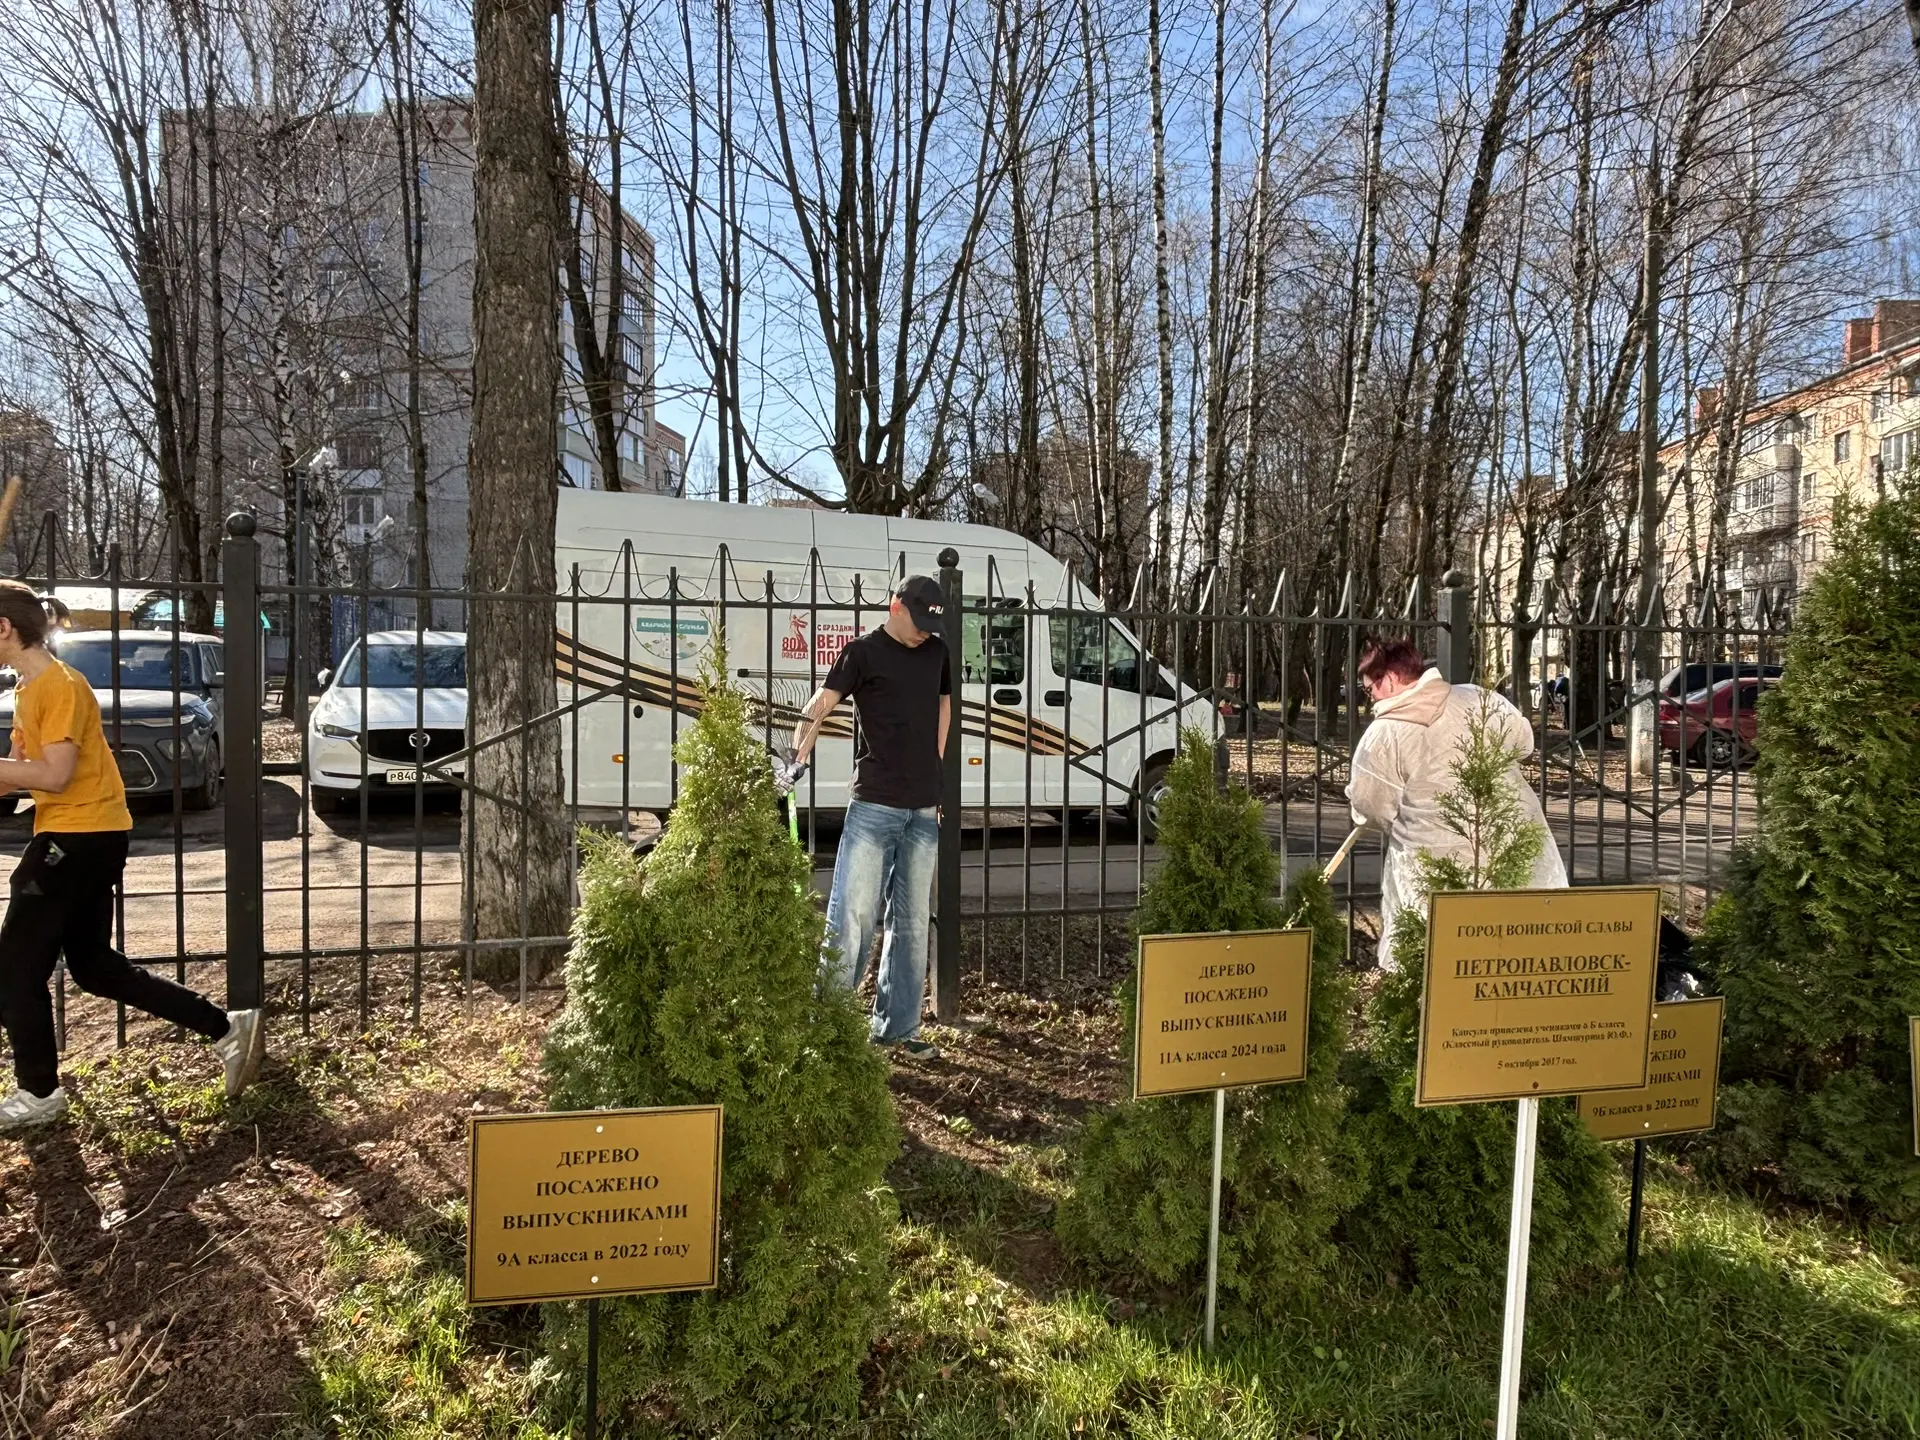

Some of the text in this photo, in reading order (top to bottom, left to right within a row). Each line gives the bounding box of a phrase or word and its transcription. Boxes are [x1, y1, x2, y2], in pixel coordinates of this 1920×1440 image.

[822, 624, 866, 633] ПРАЗДНИМ
[782, 637, 798, 651] 80
[1457, 920, 1634, 939] ГОРОД ВОИНСКОЙ СЛАВЫ
[1199, 962, 1256, 980] ДЕРЕВО
[1455, 953, 1632, 977] ПЕТРОПАВЛОВСК-
[1184, 985, 1269, 1005] ПОСАЖЕНО
[1473, 974, 1610, 999] КАМЧАТСКИЙ
[1160, 1010, 1287, 1033] ВЫПУСКНИКАМИ
[1186, 1048, 1228, 1063] класса
[1231, 1043, 1258, 1058] 2024
[1261, 1042, 1287, 1054] года
[1497, 1060, 1504, 1070] 5
[1541, 1056, 1561, 1067] 2017
[1649, 1069, 1701, 1084] НИКАМИ
[1608, 1104, 1644, 1116] класса
[1646, 1104, 1653, 1112] в
[1654, 1098, 1678, 1111] 2022
[1679, 1097, 1702, 1108] году
[556, 1147, 640, 1169] ДЕРЕВО
[536, 1175, 659, 1196] ПОСАЖЕНО
[502, 1204, 688, 1230] ВЫПУСКНИКАМИ
[496, 1242, 691, 1268] 9А класса в 2022 году
